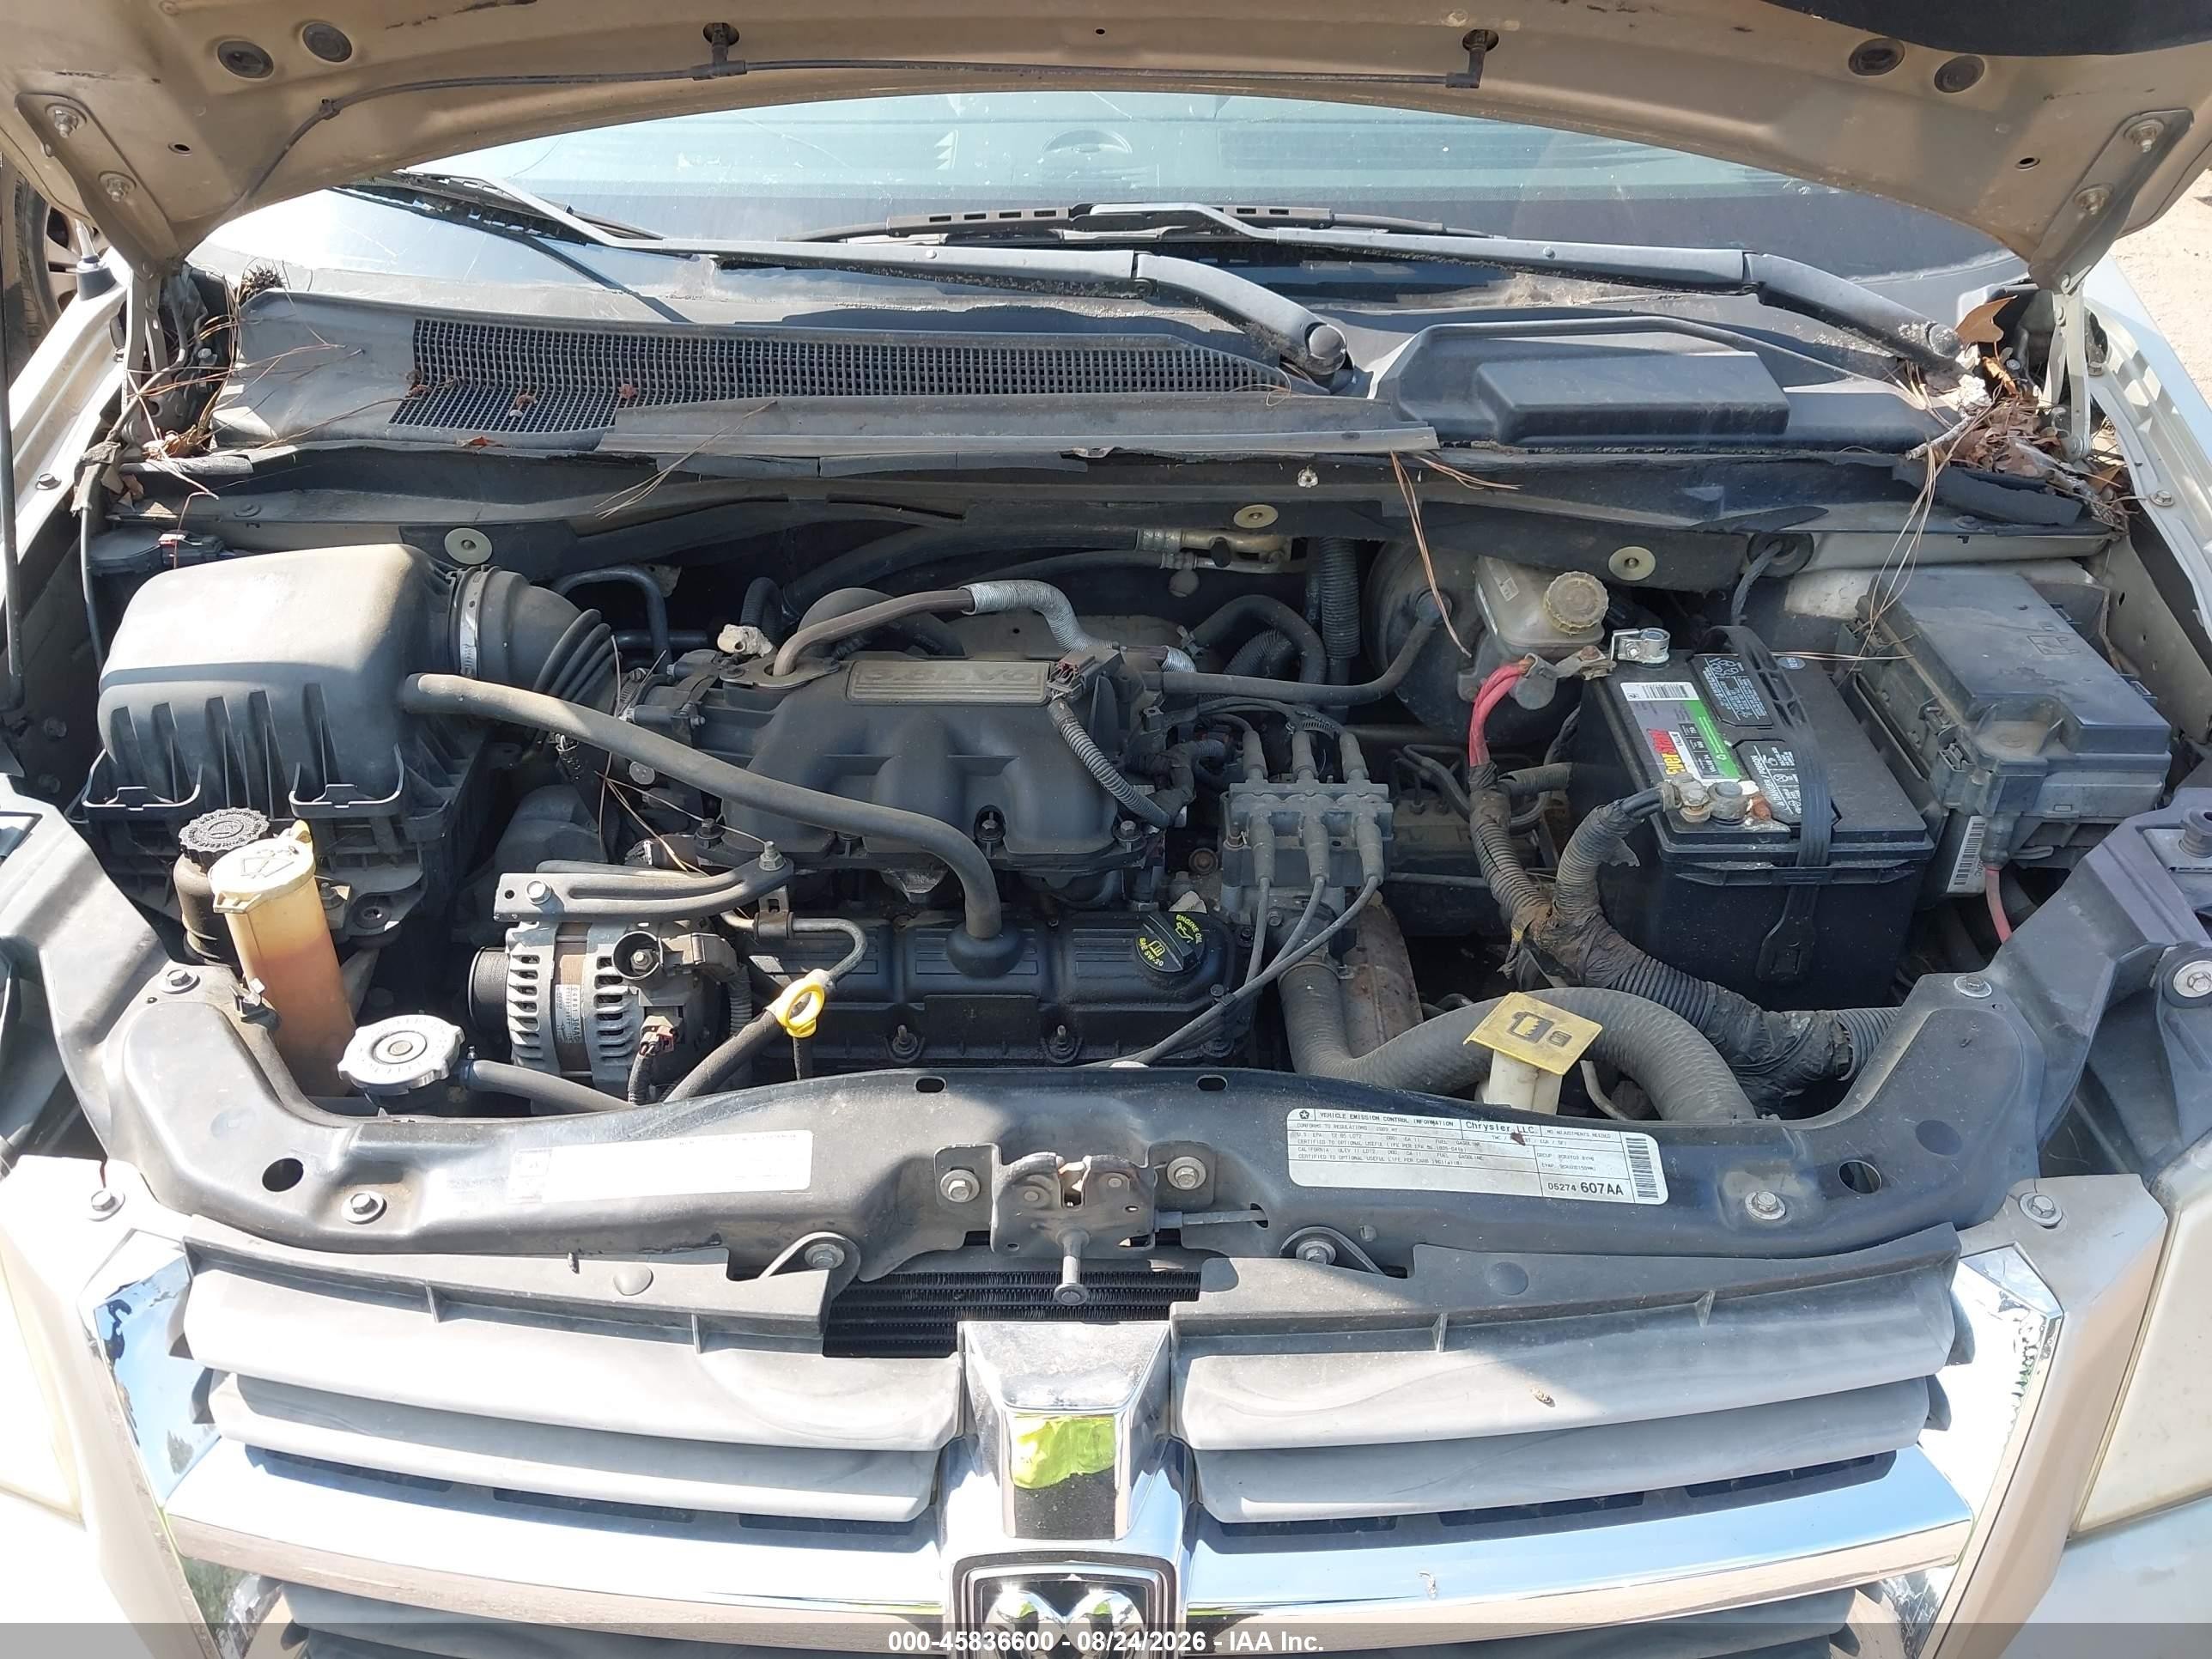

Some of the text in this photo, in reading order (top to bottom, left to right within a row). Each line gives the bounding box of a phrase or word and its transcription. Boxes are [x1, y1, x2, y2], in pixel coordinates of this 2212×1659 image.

[1750, 755, 1768, 774] POISON
[1764, 780, 1784, 800] DANGER
[1176, 915, 1203, 945] ENGINE OIL
[1139, 938, 1164, 967] SAE 5W-20
[1466, 1121, 1510, 1131] Chrysler
[1547, 1182, 1624, 1196] 05274 607AA
